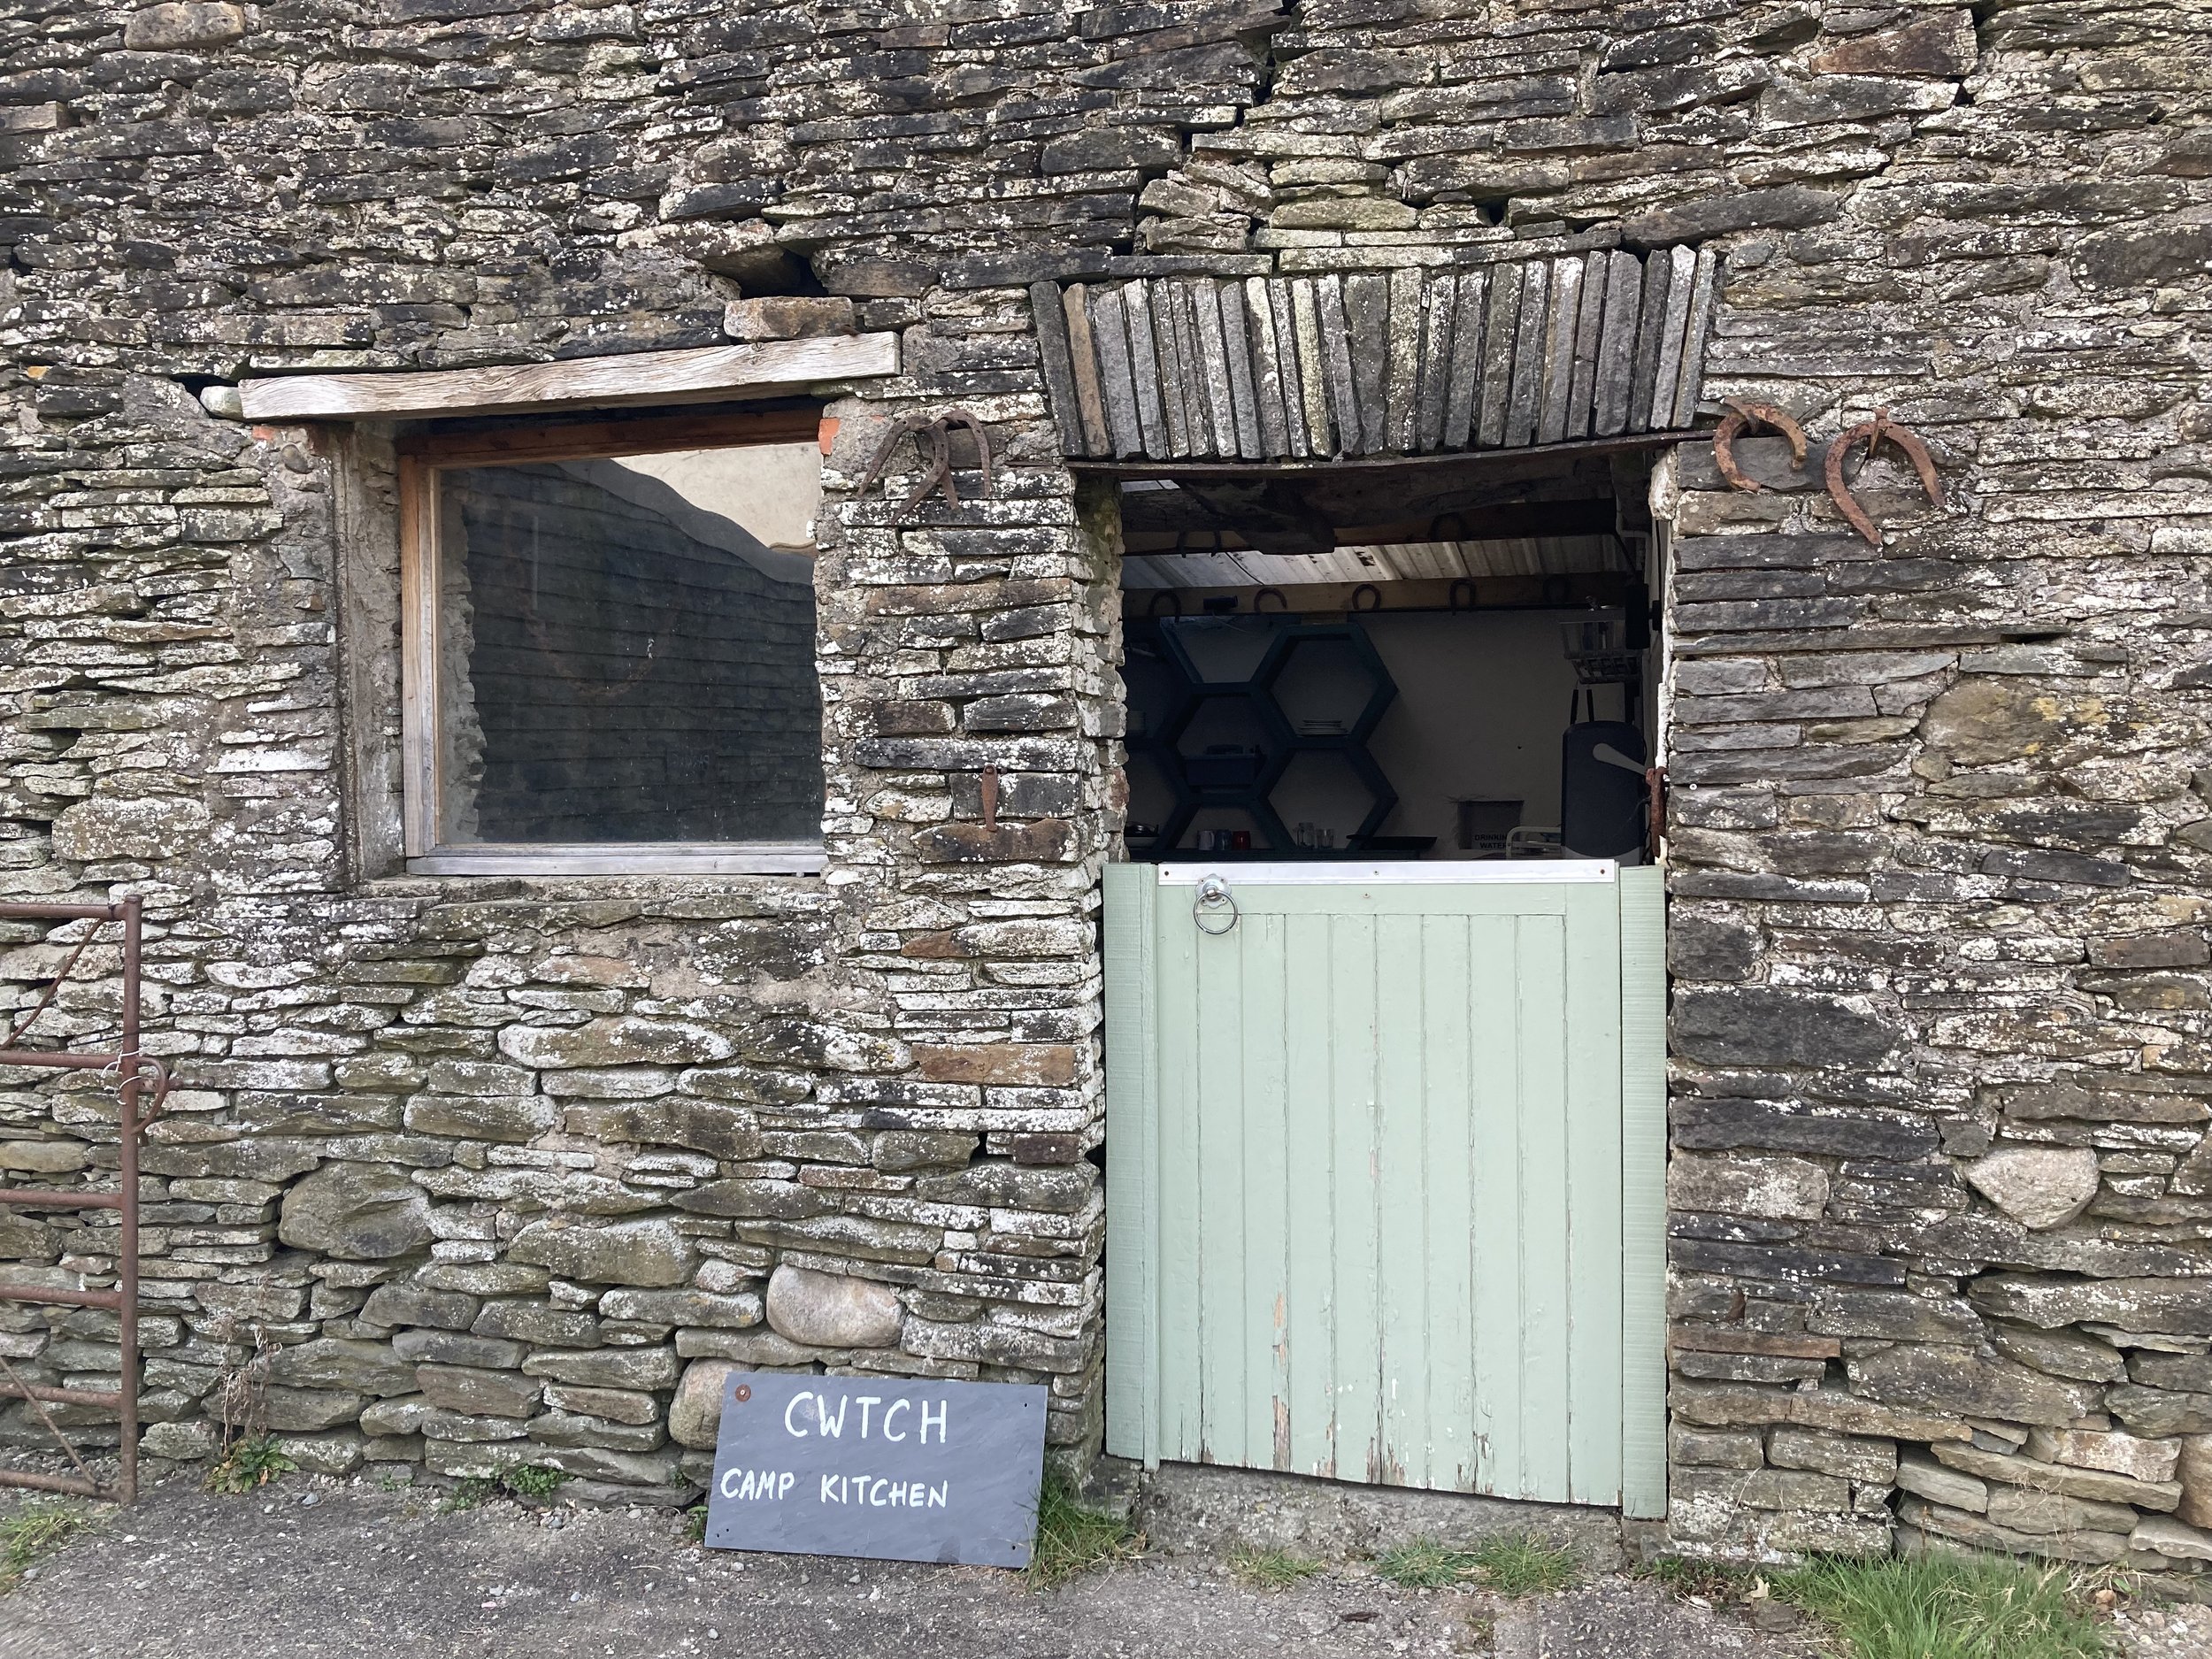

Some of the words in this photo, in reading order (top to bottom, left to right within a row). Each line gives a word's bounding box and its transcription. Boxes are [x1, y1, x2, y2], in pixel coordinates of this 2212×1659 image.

[784, 1391, 948, 1444] CWTCH
[719, 1467, 795, 1501] CAMP
[820, 1474, 949, 1508] KITCHEN
